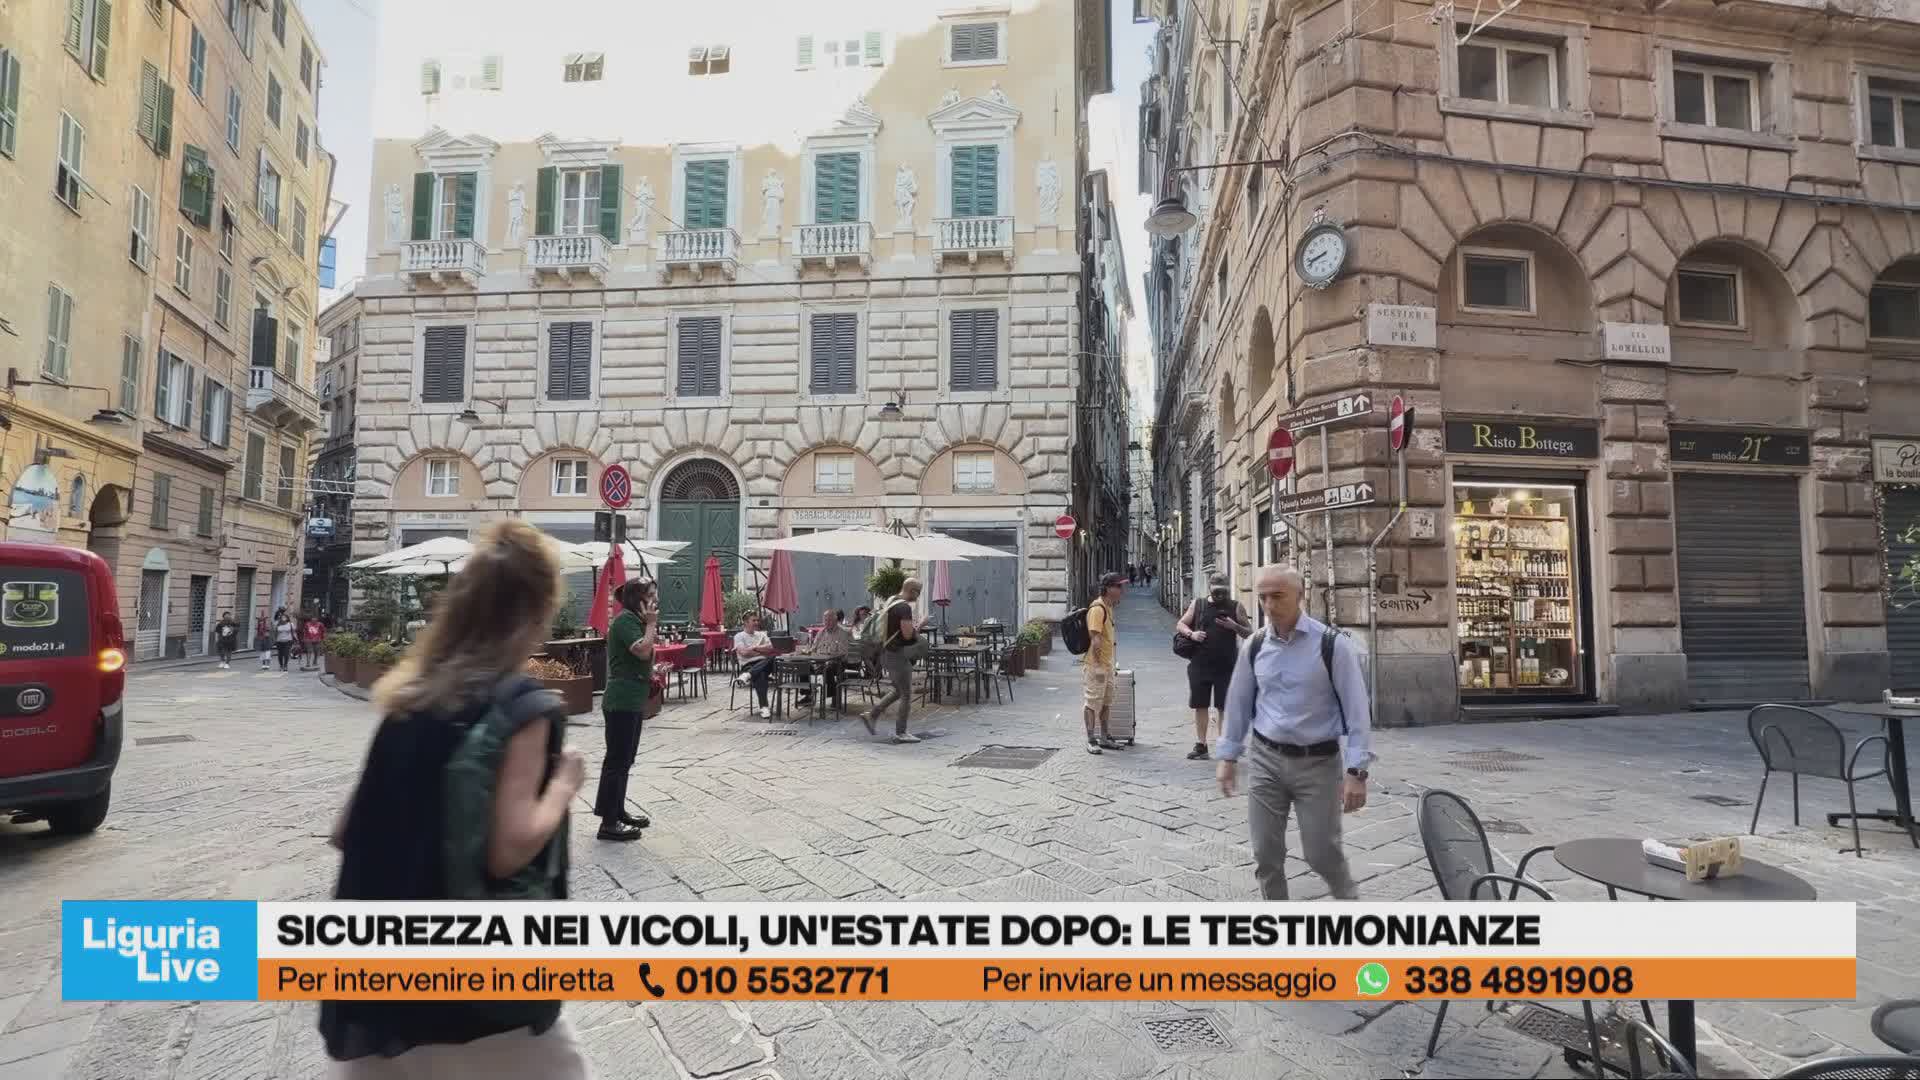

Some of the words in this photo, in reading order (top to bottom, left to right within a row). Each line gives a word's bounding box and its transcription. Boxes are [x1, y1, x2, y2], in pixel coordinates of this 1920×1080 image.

[1472, 423, 1517, 449] Risto
[1518, 426, 1574, 454] Bottega
[1712, 450, 1737, 461] modo
[12, 642, 65, 652] modo21.it
[23, 694, 40, 705] FIAT
